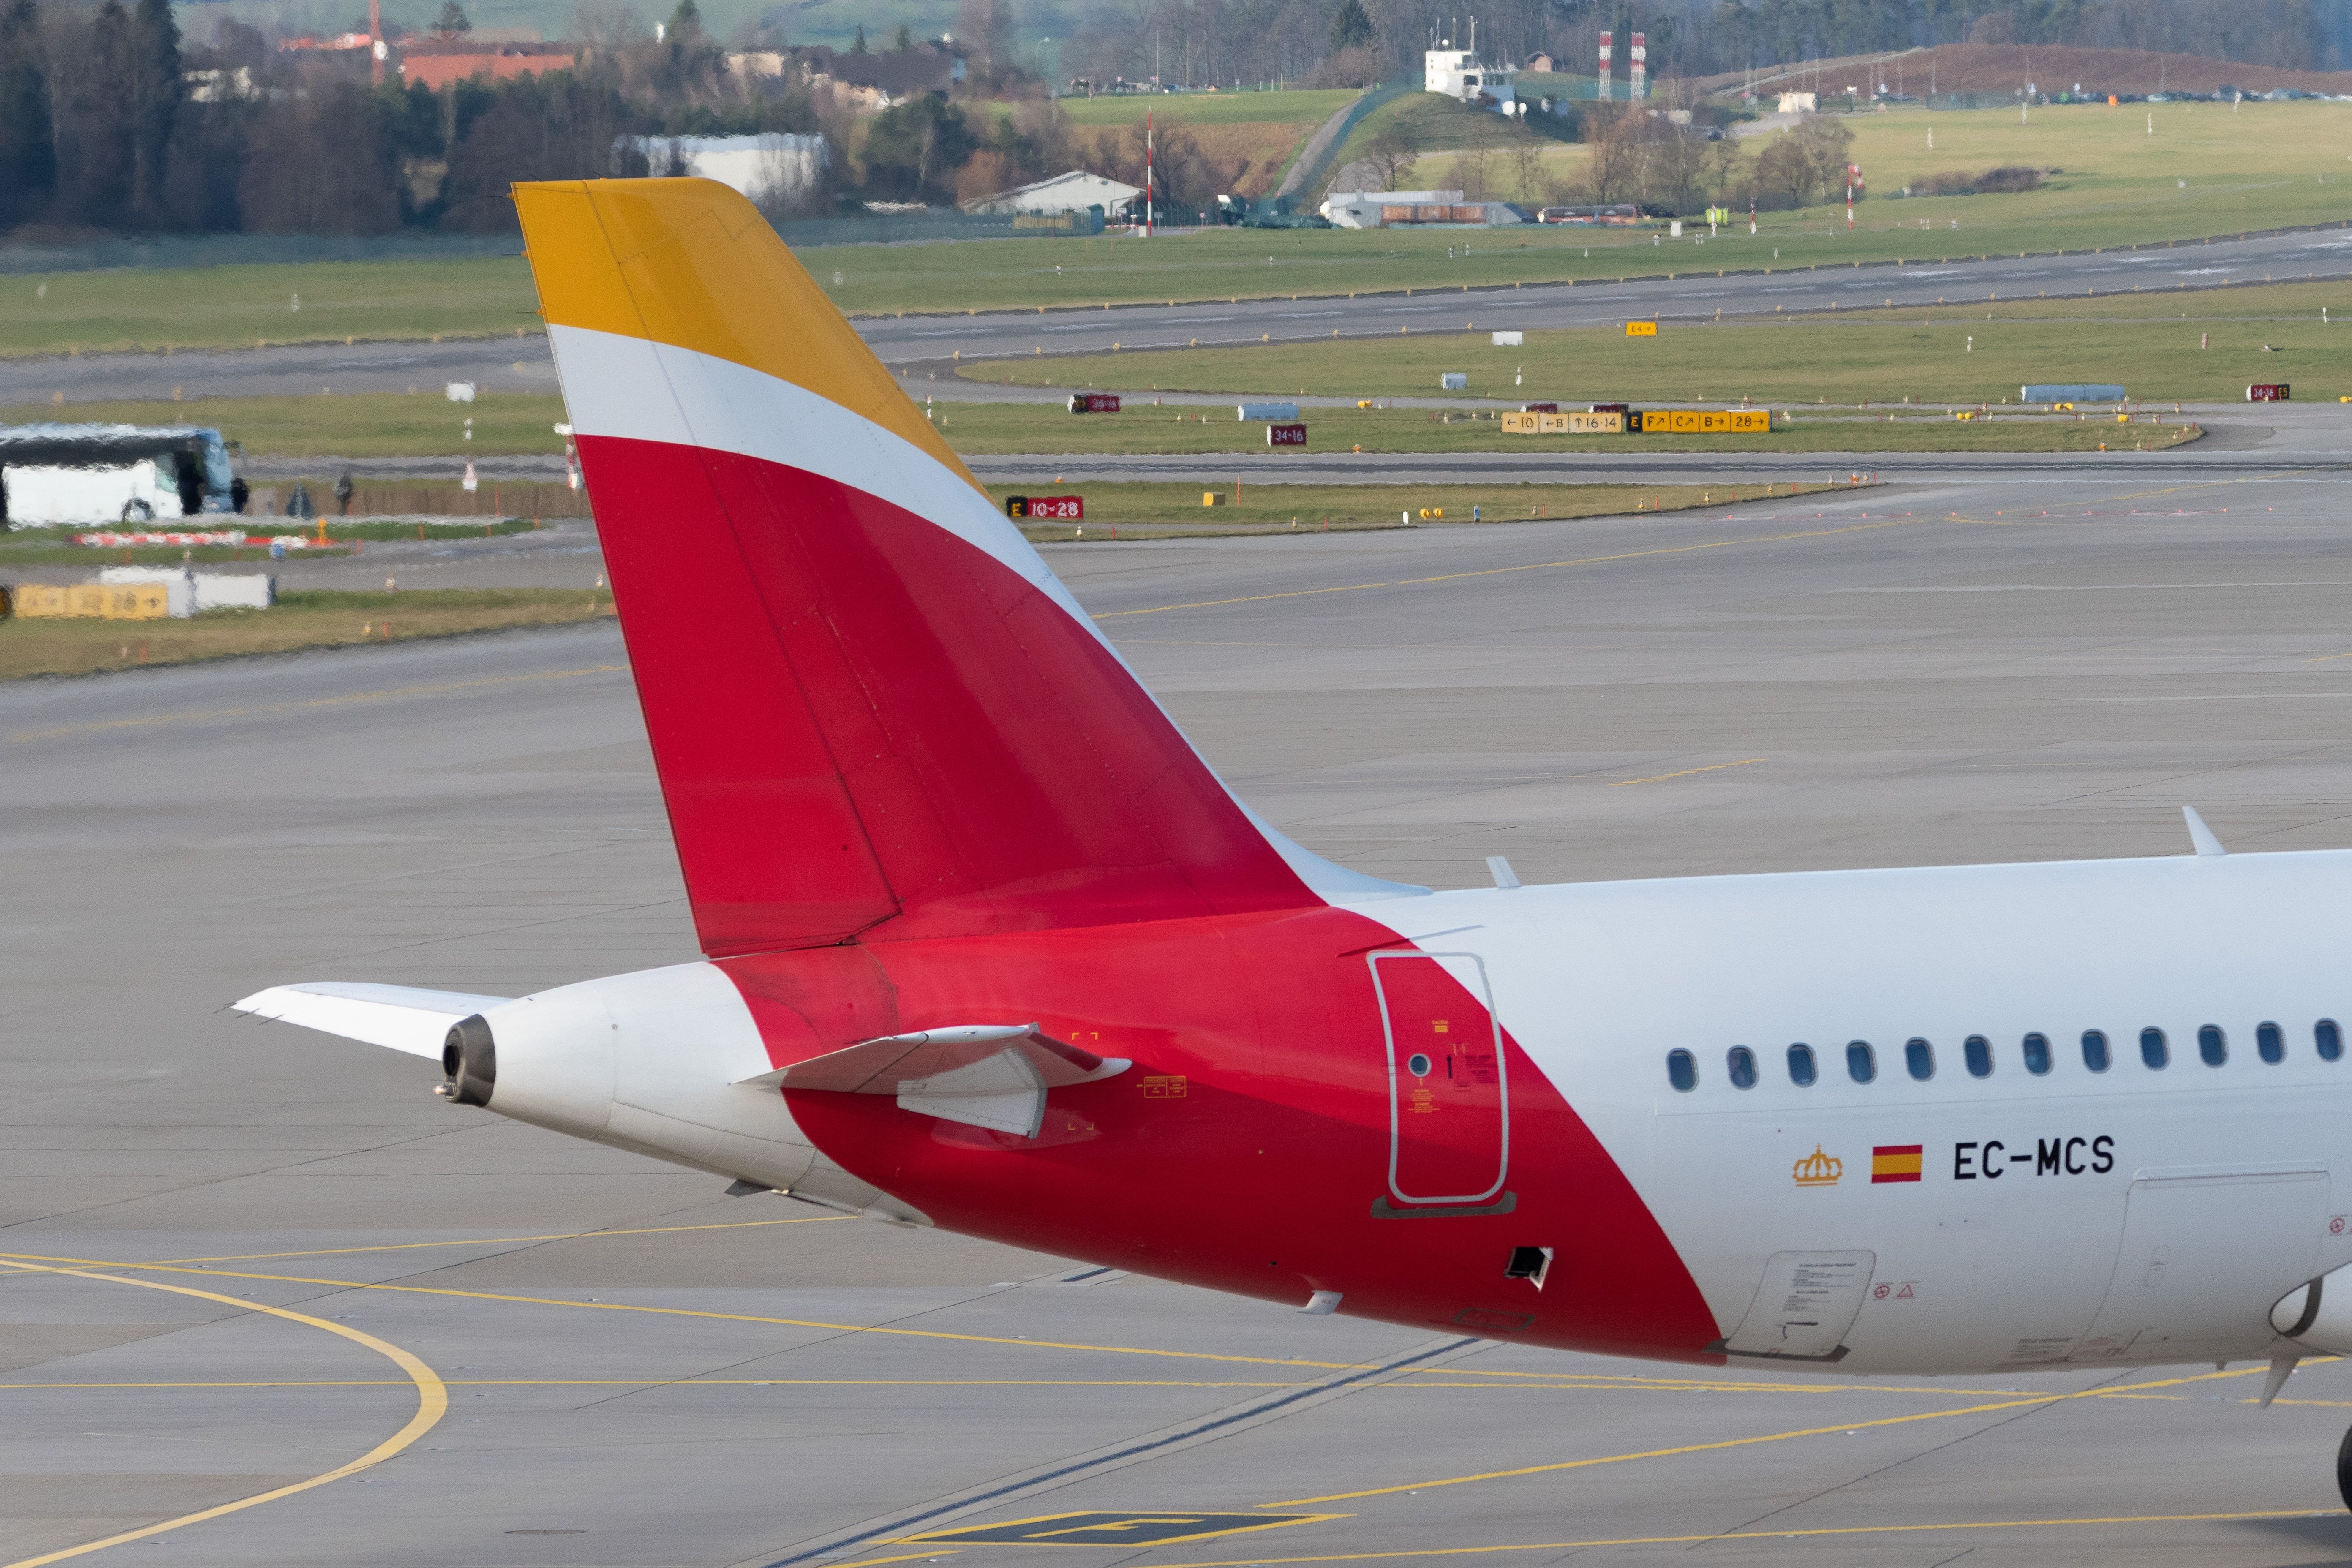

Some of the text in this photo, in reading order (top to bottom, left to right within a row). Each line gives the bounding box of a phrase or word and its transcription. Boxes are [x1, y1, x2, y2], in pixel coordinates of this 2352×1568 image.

[1521, 416, 1534, 428] 10
[1631, 416, 1752, 427] E F C B 28
[1275, 429, 1304, 442] 34-16
[1011, 501, 1078, 517] E 10-28
[1954, 1135, 2115, 1180] EC-MCS
